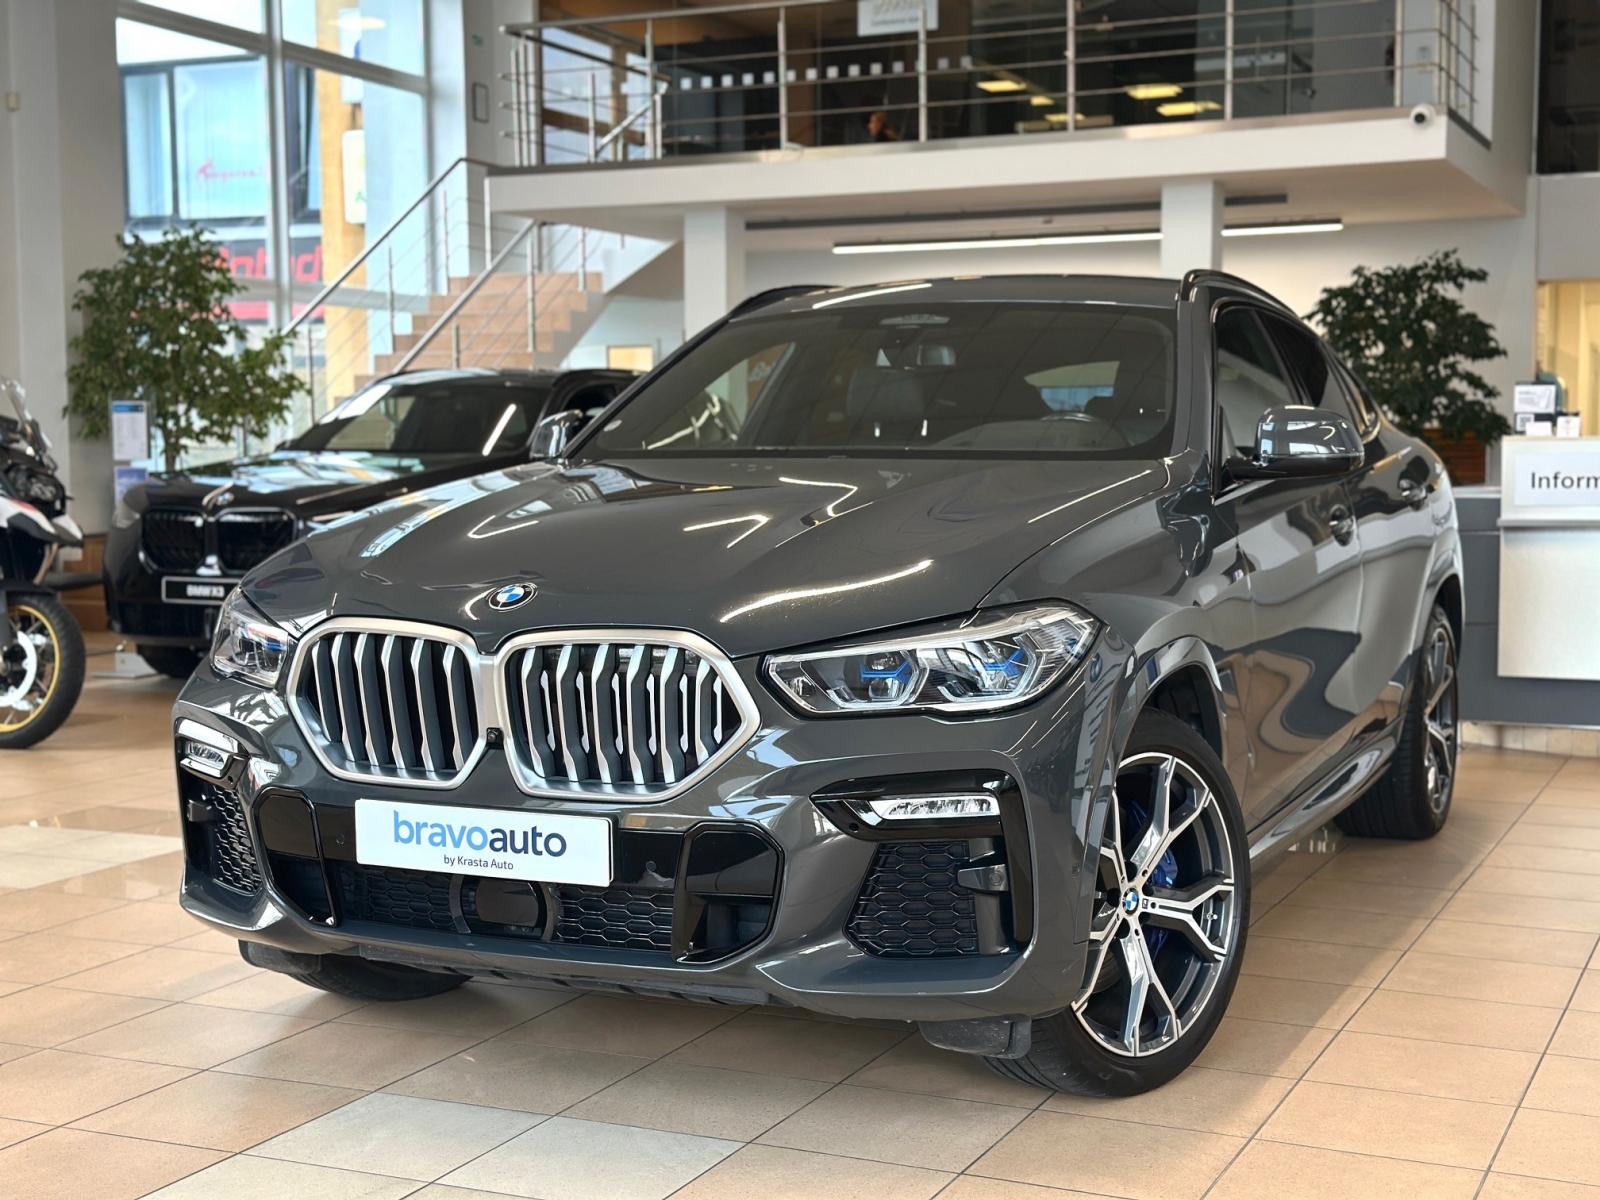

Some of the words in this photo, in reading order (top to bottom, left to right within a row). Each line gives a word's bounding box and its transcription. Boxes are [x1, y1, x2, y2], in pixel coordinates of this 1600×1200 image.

[393, 810, 567, 857] bravoauto
[443, 854, 456, 867] by
[457, 855, 489, 868] Krasta
[490, 858, 514, 870] Auto
